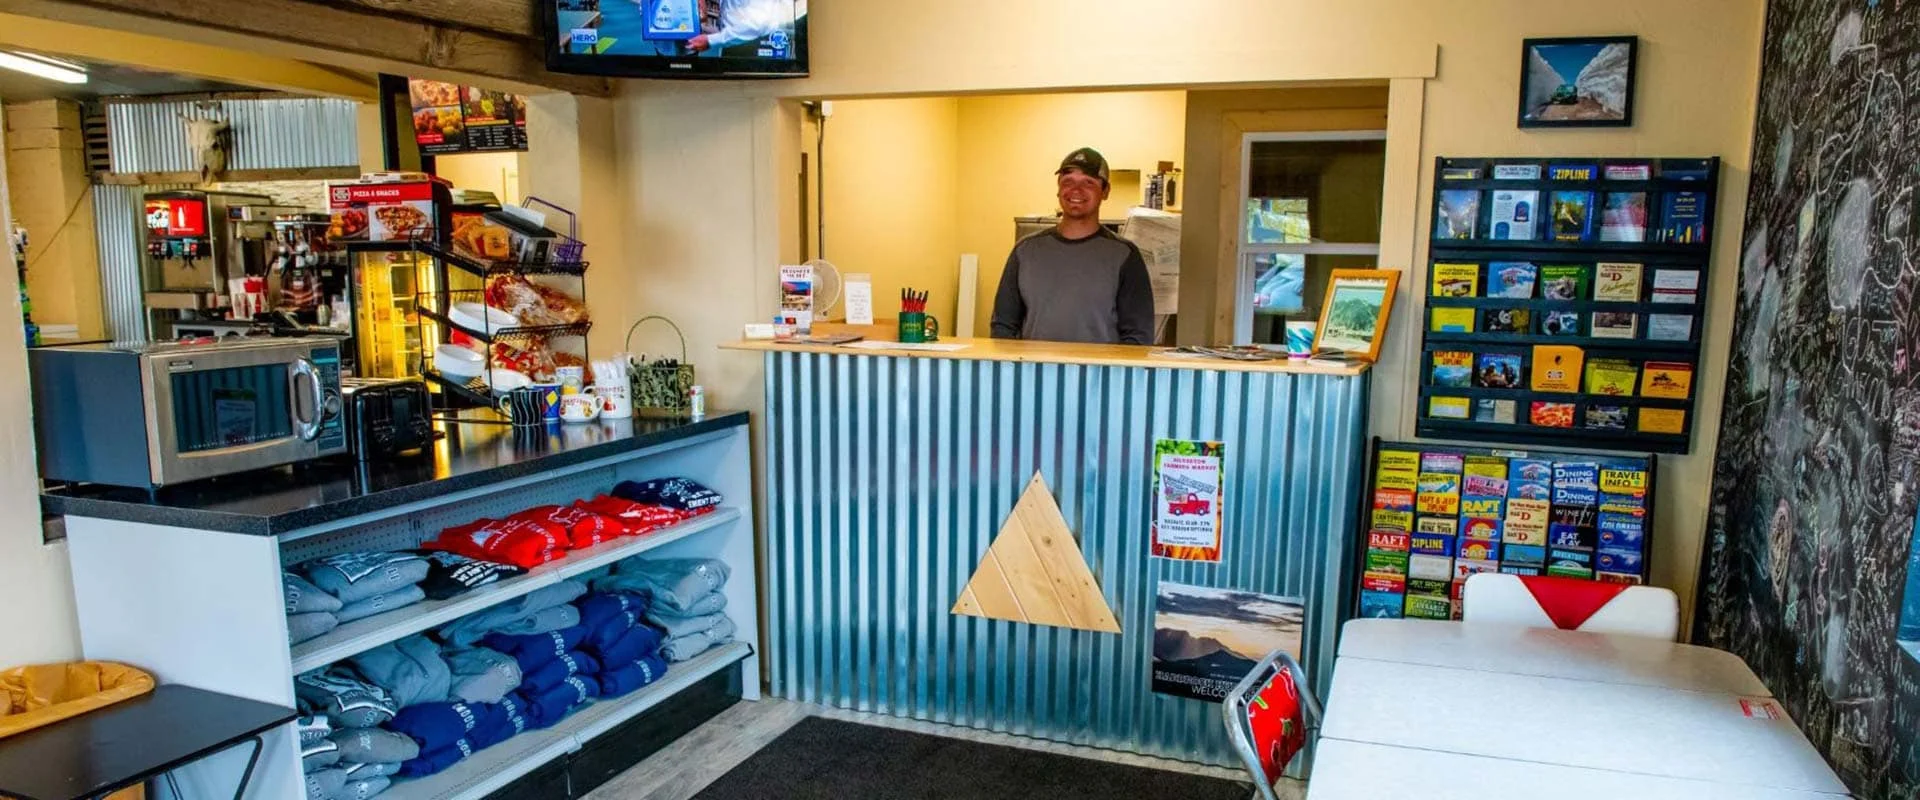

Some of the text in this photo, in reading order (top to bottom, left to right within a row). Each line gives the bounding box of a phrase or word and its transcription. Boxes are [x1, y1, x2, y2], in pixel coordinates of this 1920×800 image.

[572, 33, 597, 42] HERO
[1556, 168, 1590, 180] ZIPLINE
[1555, 468, 1594, 478] DINING
[1605, 470, 1641, 481] TRAVEL
[1605, 478, 1631, 487] INFO
[1556, 489, 1595, 501] DINING
[1462, 500, 1500, 514] RAFT
[1467, 526, 1498, 537] JEEP
[1560, 531, 1580, 541] EAT
[1371, 533, 1406, 547] RAFT
[1411, 537, 1444, 550] ZIPLINE
[1557, 539, 1581, 547] PLAY
[1461, 548, 1495, 560] RAFT
[1191, 684, 1232, 699] WELCO
